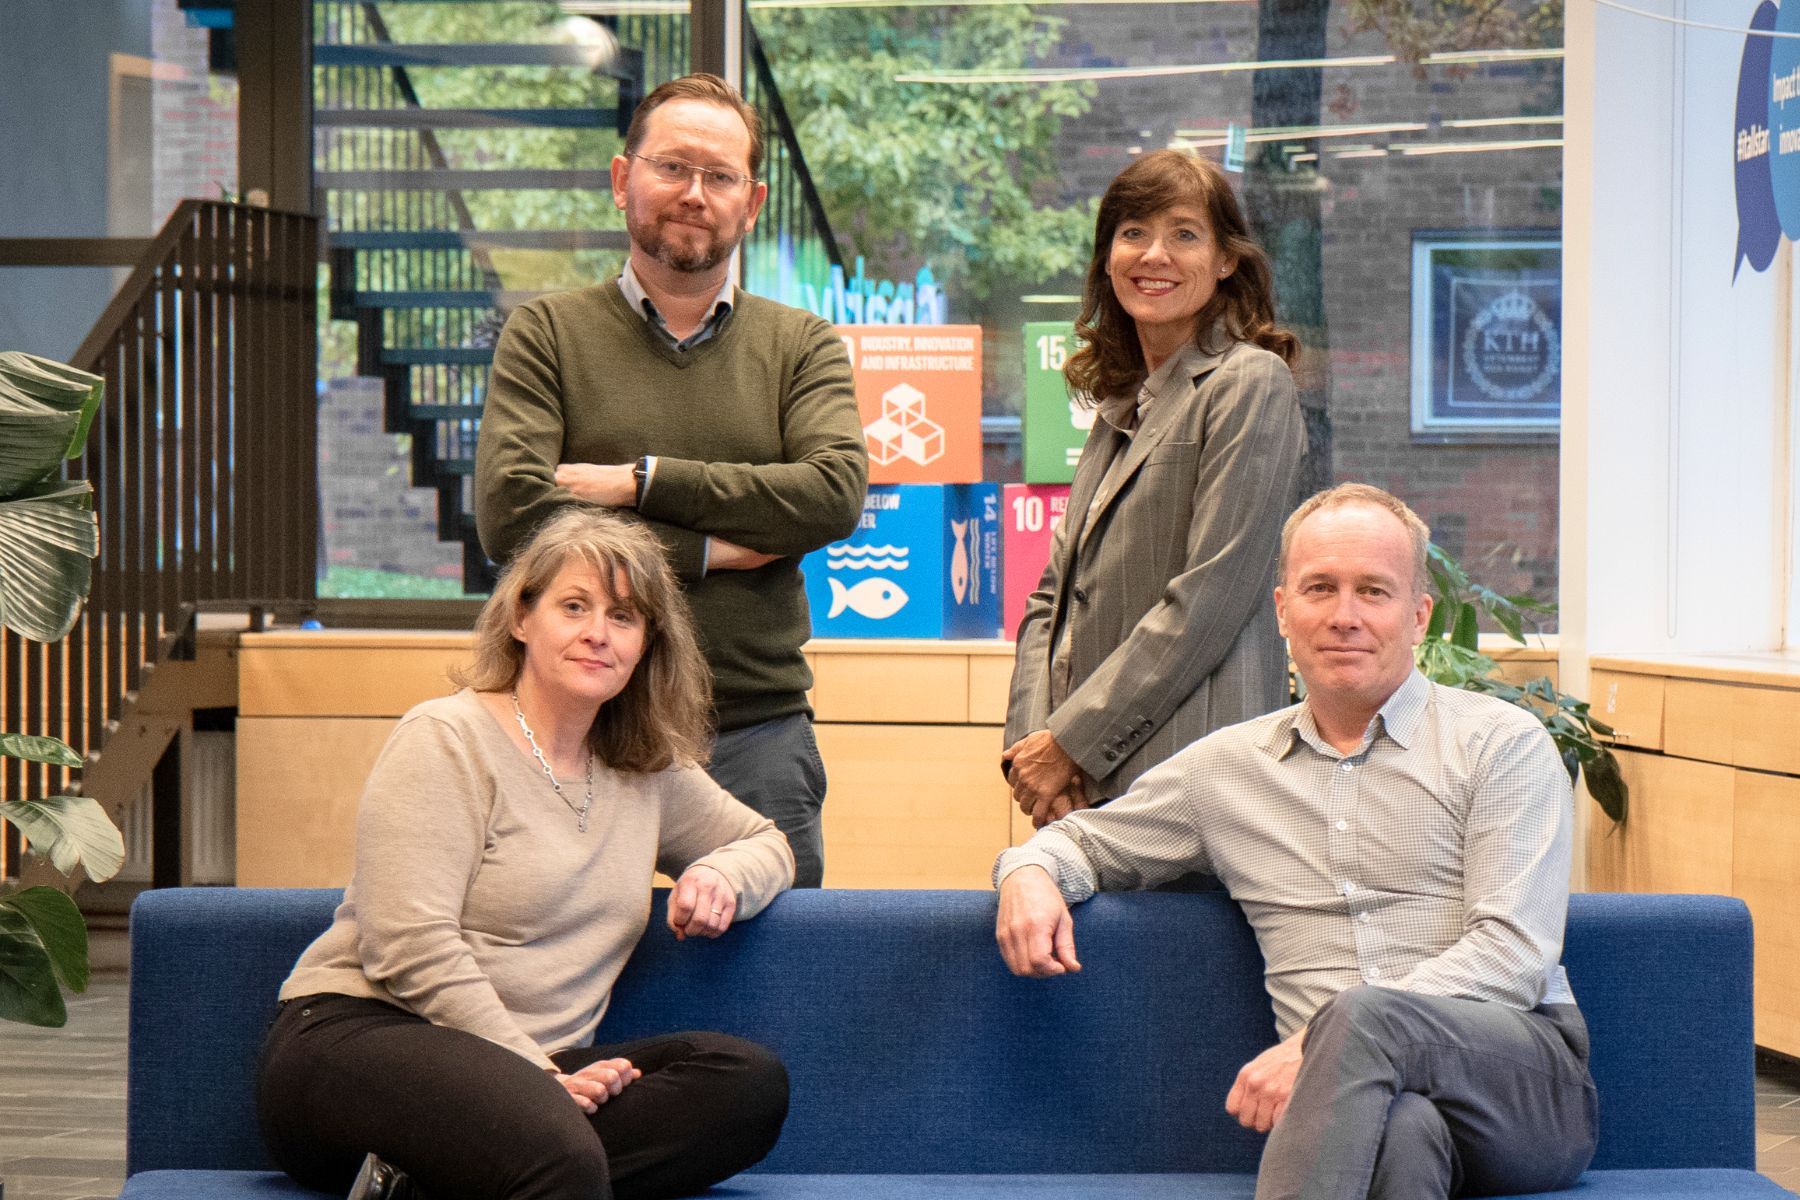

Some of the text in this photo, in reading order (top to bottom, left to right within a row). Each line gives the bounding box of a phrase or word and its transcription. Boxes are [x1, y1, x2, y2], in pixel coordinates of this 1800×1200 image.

[914, 336, 974, 351] INNOVATION
[1037, 335, 1067, 371] 15
[1483, 330, 1540, 352] KTH
[861, 355, 974, 371] AND INFRASTRUCTURE
[984, 493, 997, 521] 14
[1012, 496, 1043, 532] 10
